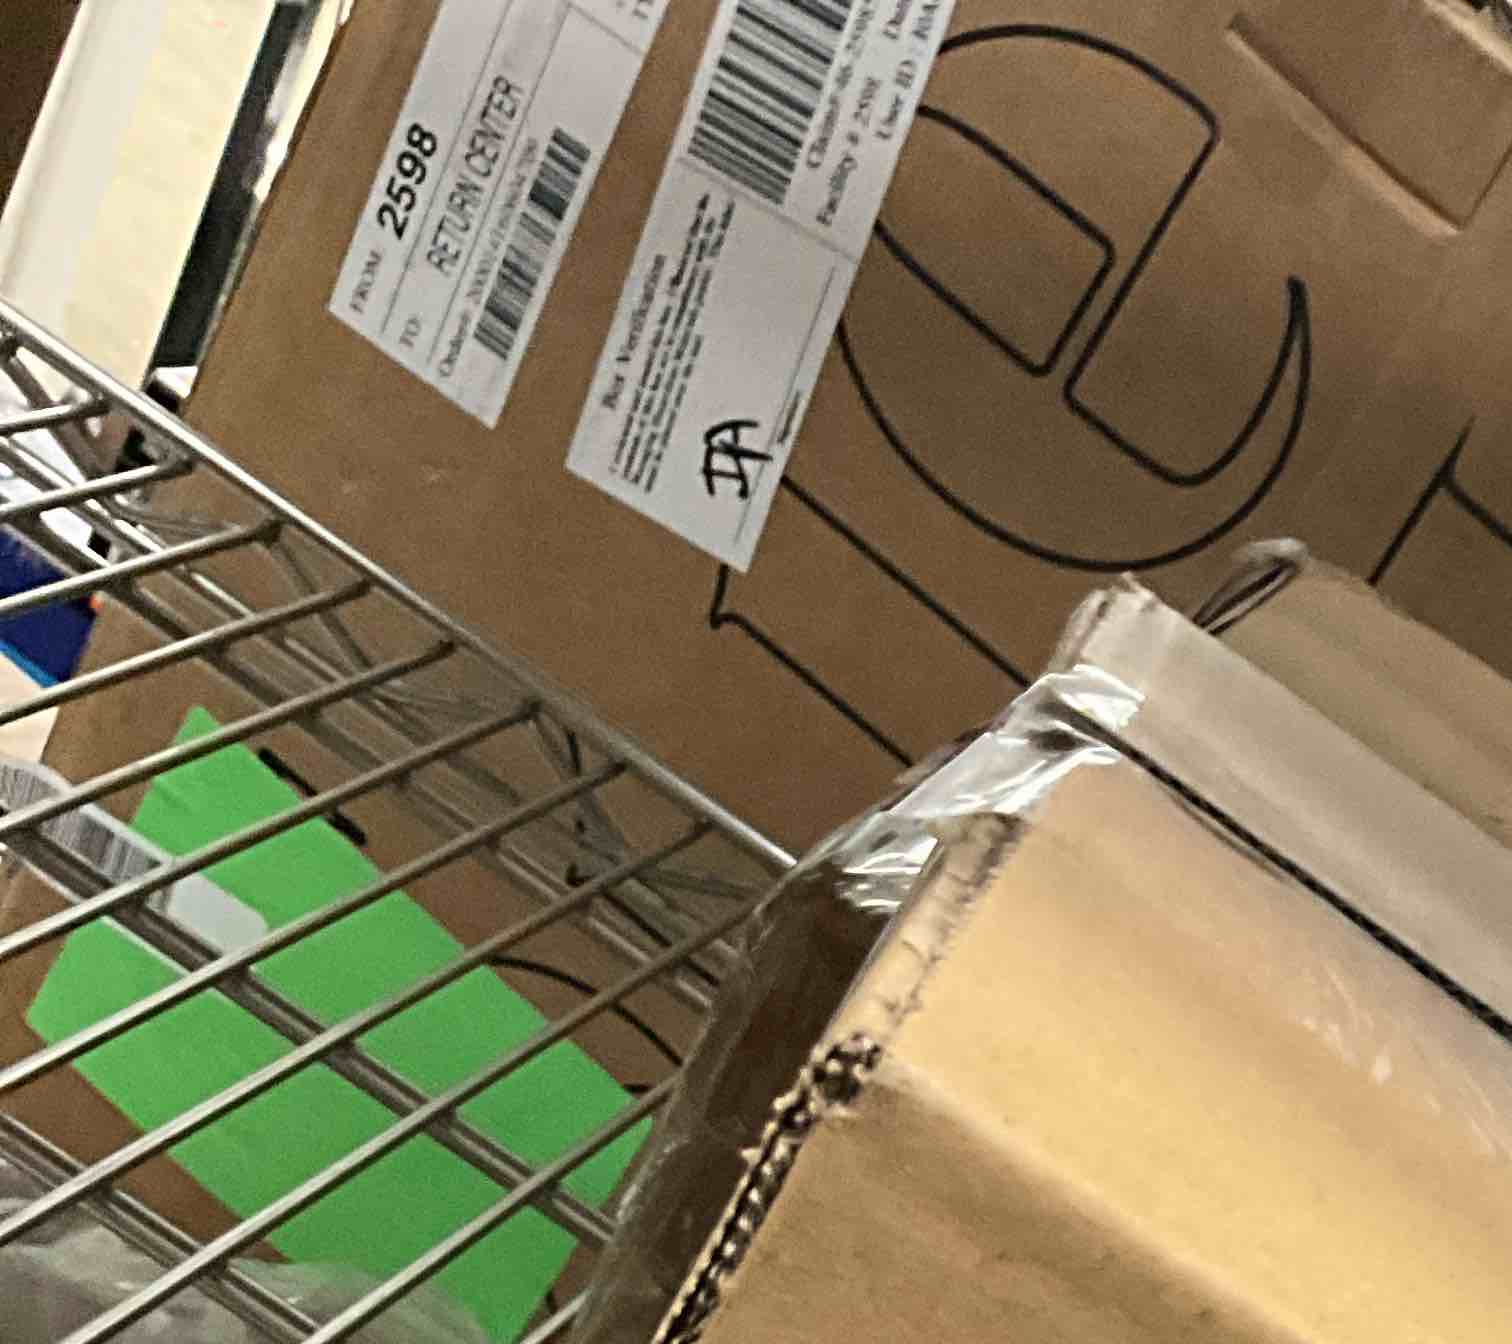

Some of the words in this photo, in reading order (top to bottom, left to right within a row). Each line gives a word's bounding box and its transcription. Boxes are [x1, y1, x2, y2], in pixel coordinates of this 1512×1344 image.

[377, 122, 438, 240] 2598
[426, 178, 482, 278] RETURN
[465, 75, 526, 179] CENTER
